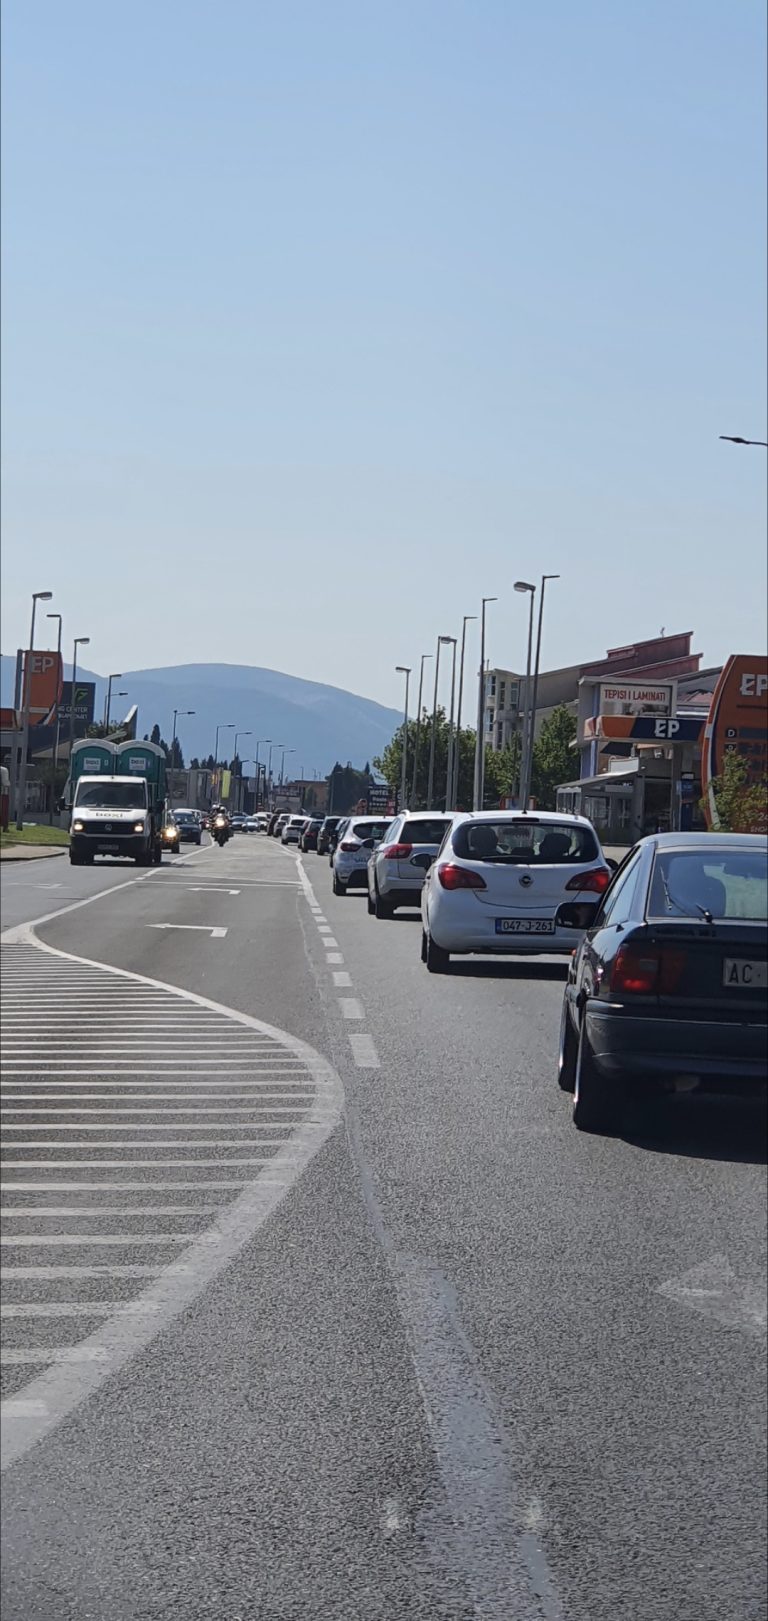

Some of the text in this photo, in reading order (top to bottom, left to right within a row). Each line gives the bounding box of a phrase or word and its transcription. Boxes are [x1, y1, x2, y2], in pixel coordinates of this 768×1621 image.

[31, 656, 54, 673] EP
[740, 673, 767, 696] EP
[604, 689, 666, 702] TEPISI I LAMINATI
[654, 719, 680, 738] EP
[727, 729, 736, 738] D
[503, 920, 553, 931] 047-J-261
